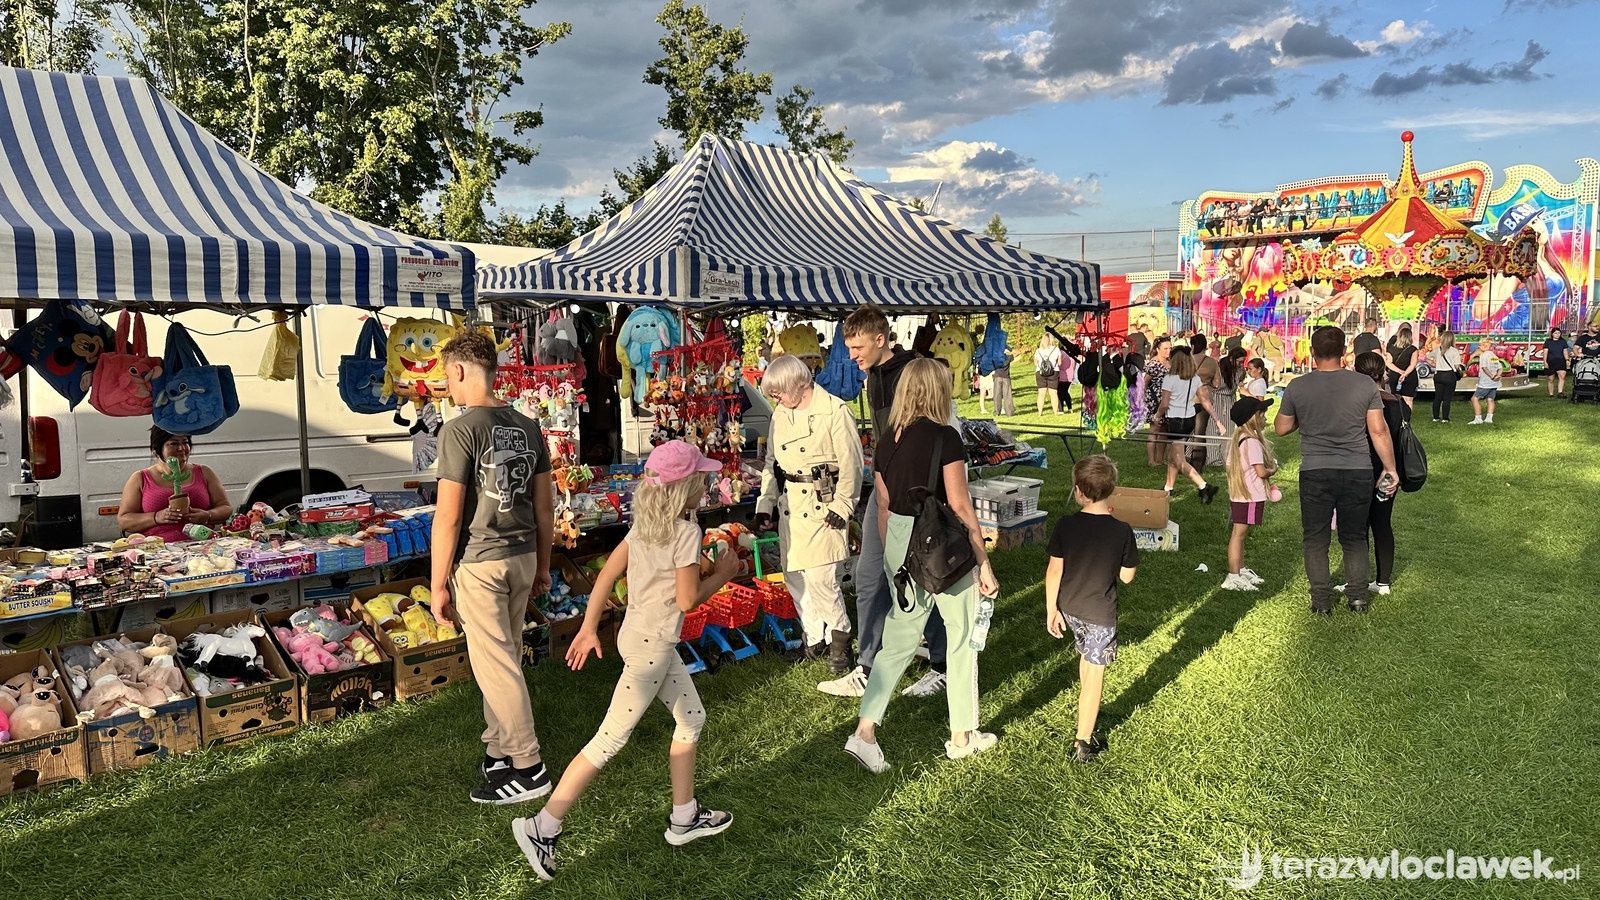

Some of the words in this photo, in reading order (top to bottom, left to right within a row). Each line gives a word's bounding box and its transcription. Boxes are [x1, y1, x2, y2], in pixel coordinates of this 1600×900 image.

[8, 602, 30, 611] BUTTER
[31, 598, 54, 607] SQUISHY
[231, 685, 271, 699] Bananas
[258, 724, 283, 734] Product
[24, 732, 74, 748] Premium
[224, 733, 250, 744] Ecuador
